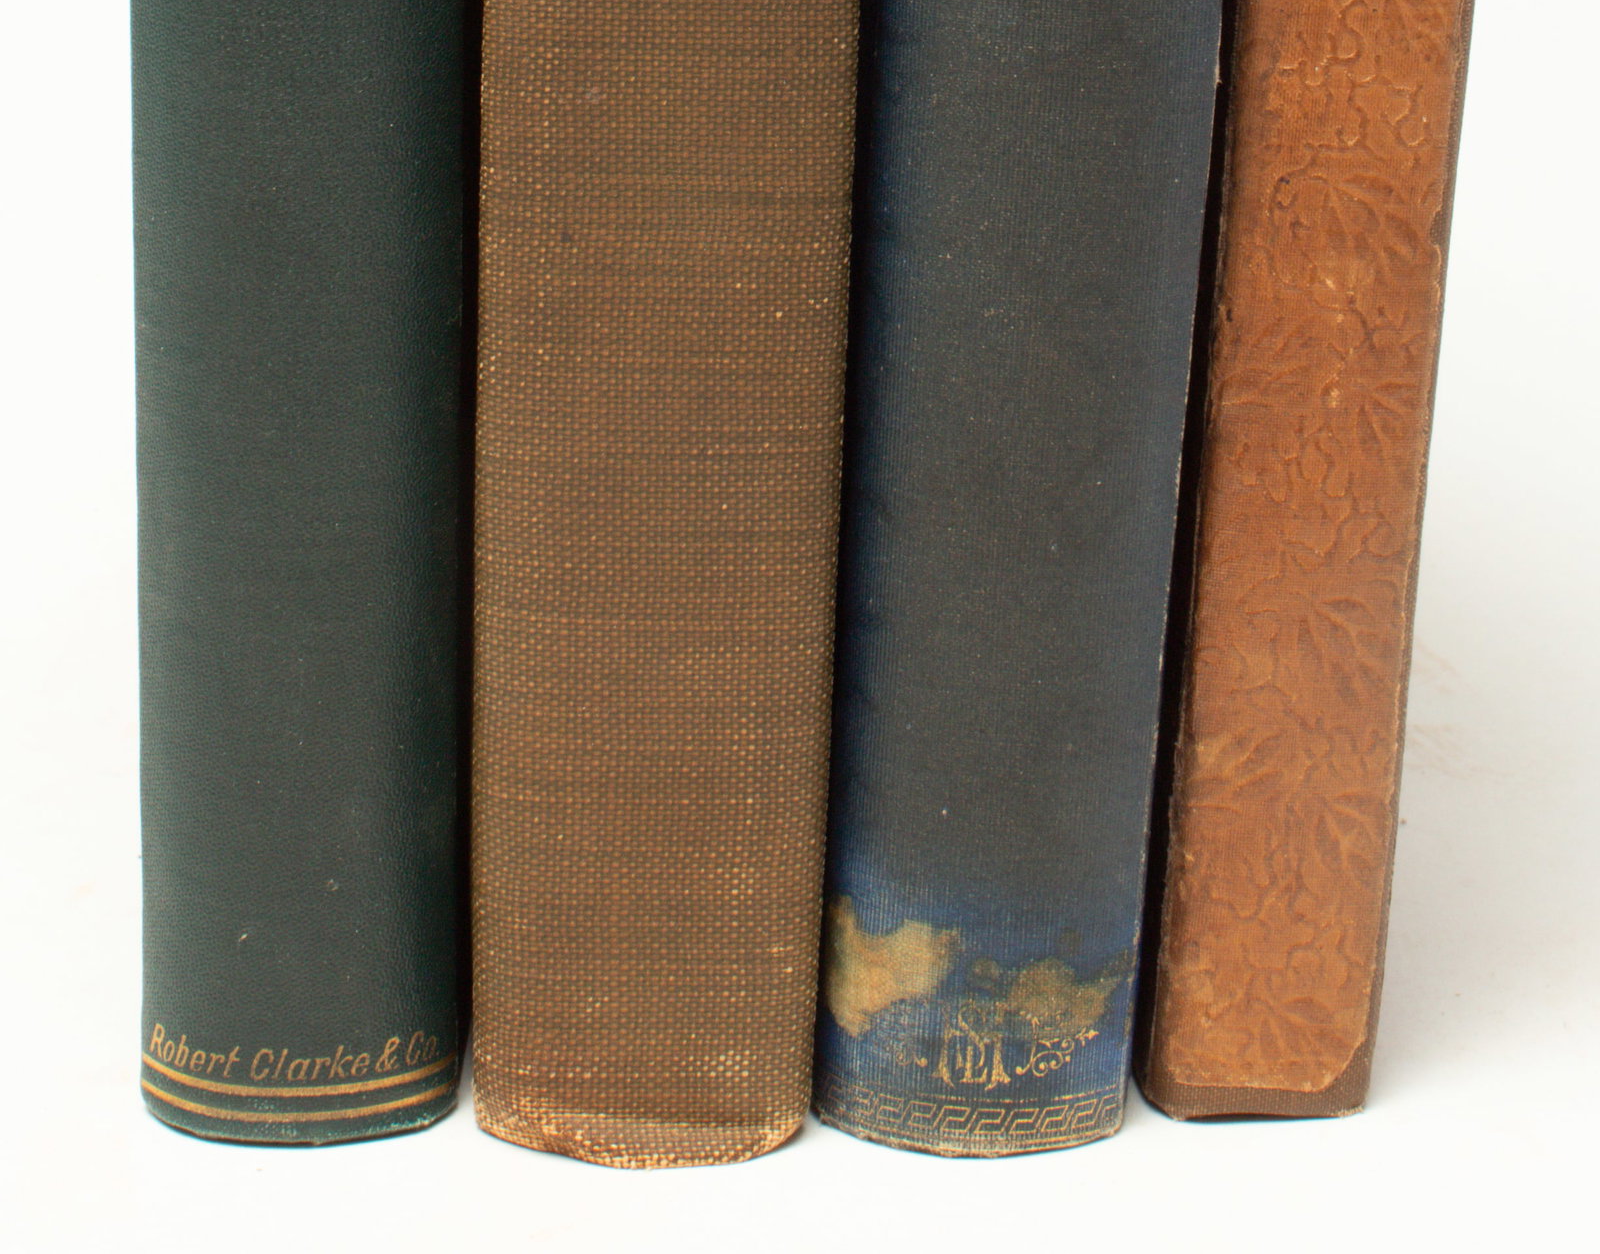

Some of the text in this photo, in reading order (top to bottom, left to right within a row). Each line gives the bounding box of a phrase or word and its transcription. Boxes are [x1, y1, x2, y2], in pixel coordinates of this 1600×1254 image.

[150, 1023, 241, 1080] Robert
[249, 1045, 371, 1082] Clarke
[374, 1037, 401, 1074] &
